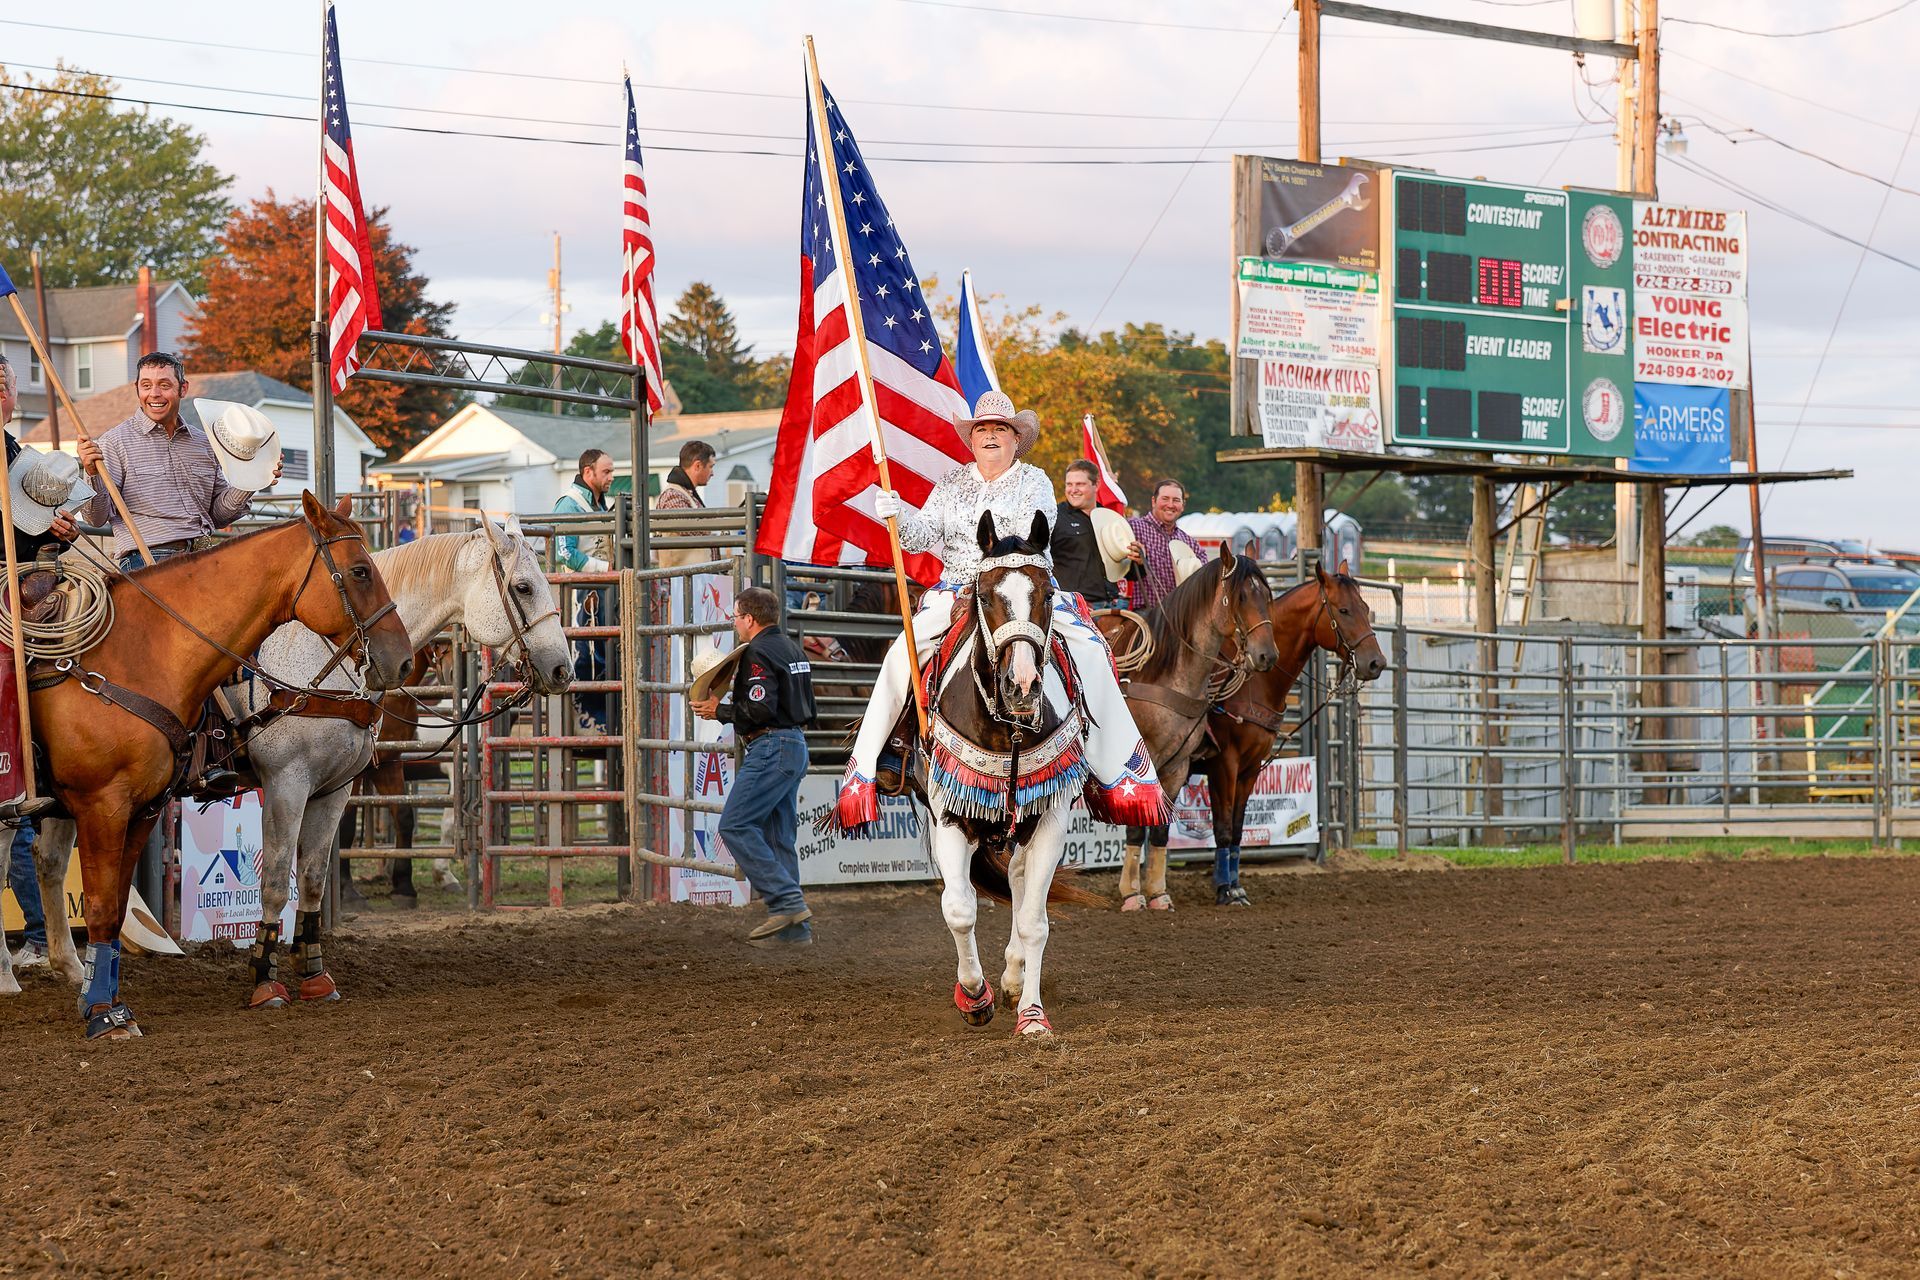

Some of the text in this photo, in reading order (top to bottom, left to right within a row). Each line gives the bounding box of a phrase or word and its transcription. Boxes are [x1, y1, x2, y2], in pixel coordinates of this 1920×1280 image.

[1467, 203, 1543, 230] CONTESTANT
[1642, 207, 1726, 231] ALTMIRE
[1633, 230, 1739, 254] CONTRACTING
[1521, 263, 1564, 285] SCORE/
[1523, 287, 1549, 307] TIME
[1651, 296, 1722, 318] YOUNG
[1638, 316, 1731, 343] Electric
[1466, 335, 1552, 360] EVENT LEADER
[1647, 346, 1723, 361] HOOKER PA
[1335, 368, 1371, 395] HVAC
[1521, 396, 1565, 418] SCORE/
[1634, 404, 1725, 432] FARMERS
[1521, 420, 1548, 440] TIME
[1696, 432, 1725, 443] BANK
[838, 859, 928, 876] Complete Water Well Drilling
[197, 891, 232, 908] LIBERTY
[215, 910, 228, 919] Your
[229, 908, 245, 918] Local
[214, 924, 236, 939] (844)
